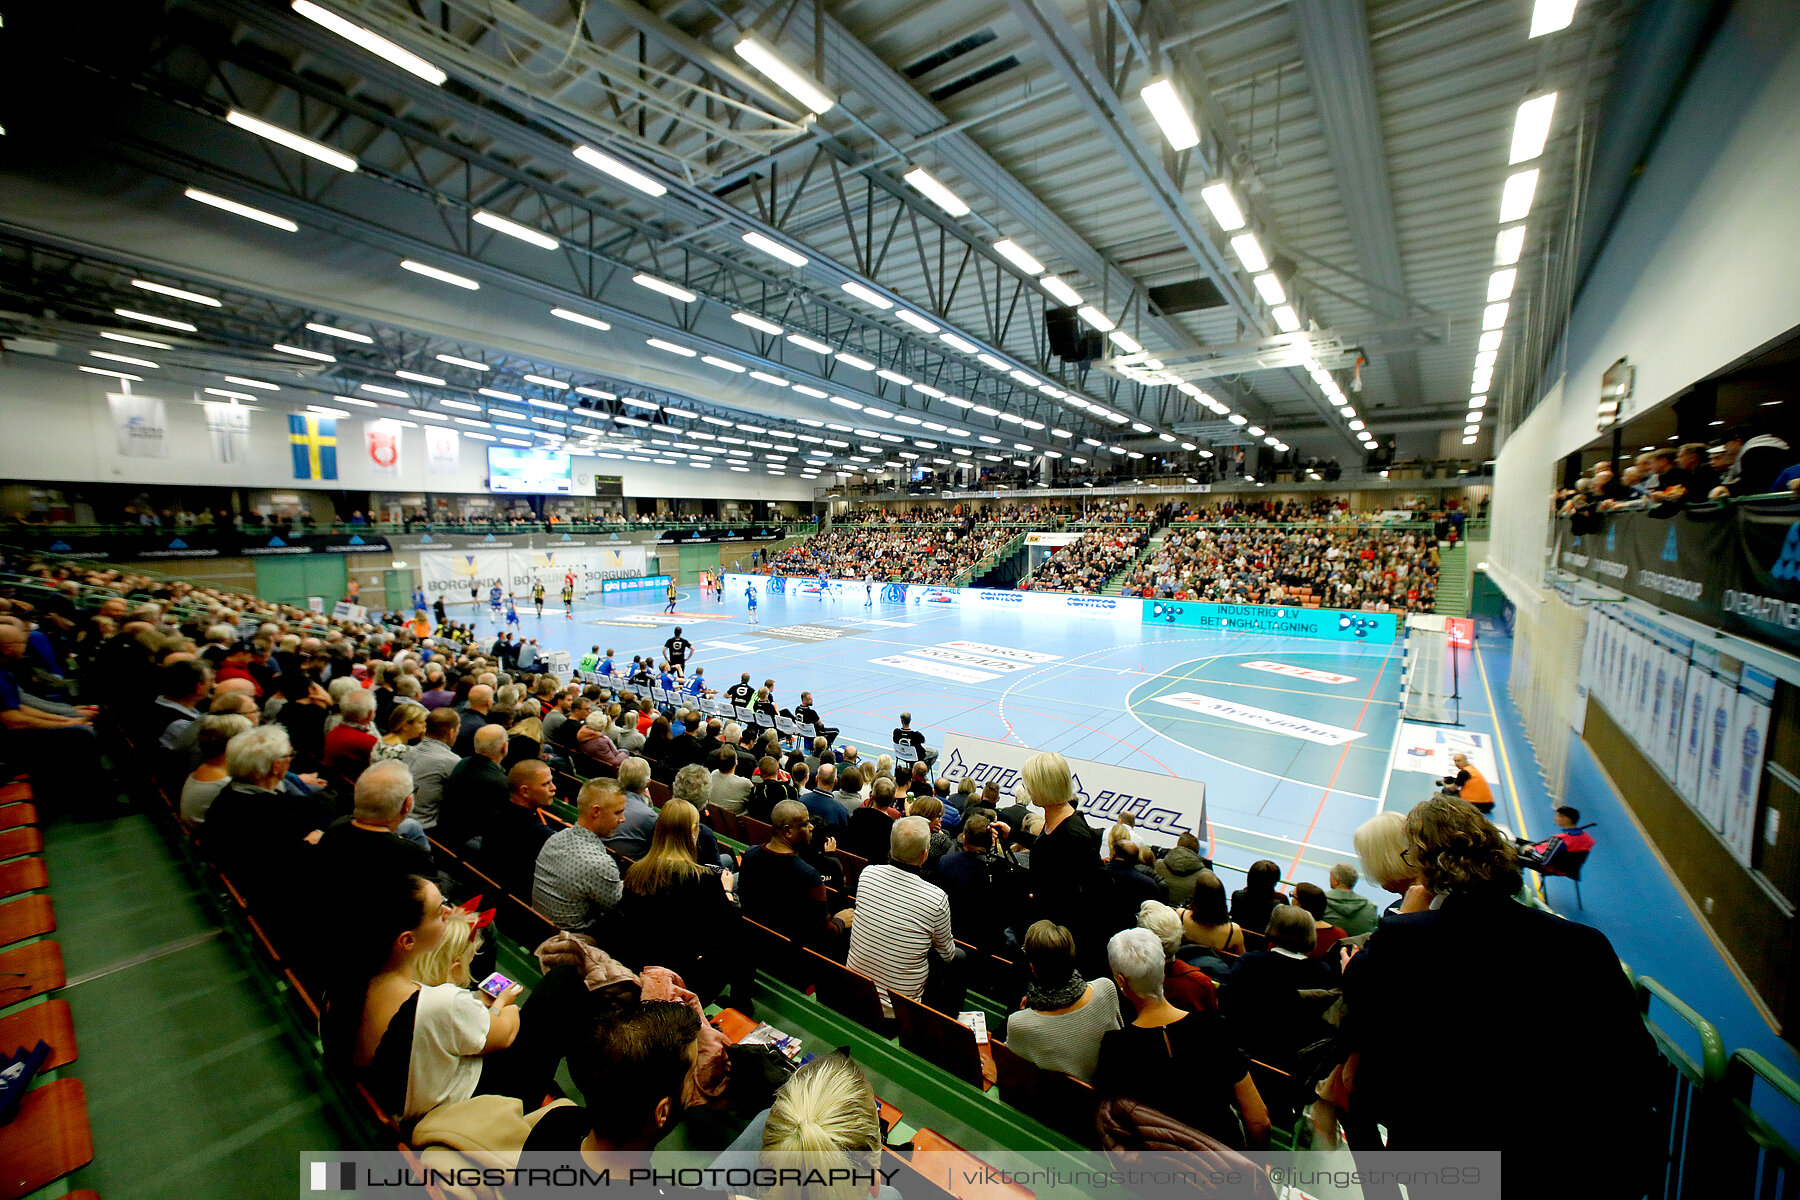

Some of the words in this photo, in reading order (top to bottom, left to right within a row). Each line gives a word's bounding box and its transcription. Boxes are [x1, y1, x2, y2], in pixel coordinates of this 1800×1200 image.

[587, 569, 642, 581] BORGUNDA
[428, 578, 504, 592] BORGNDA
[980, 591, 1023, 603] CONTECO
[1067, 597, 1117, 609] CONTECO
[1217, 605, 1300, 619] INDUSTRIGOLV
[942, 747, 1023, 797] bili
